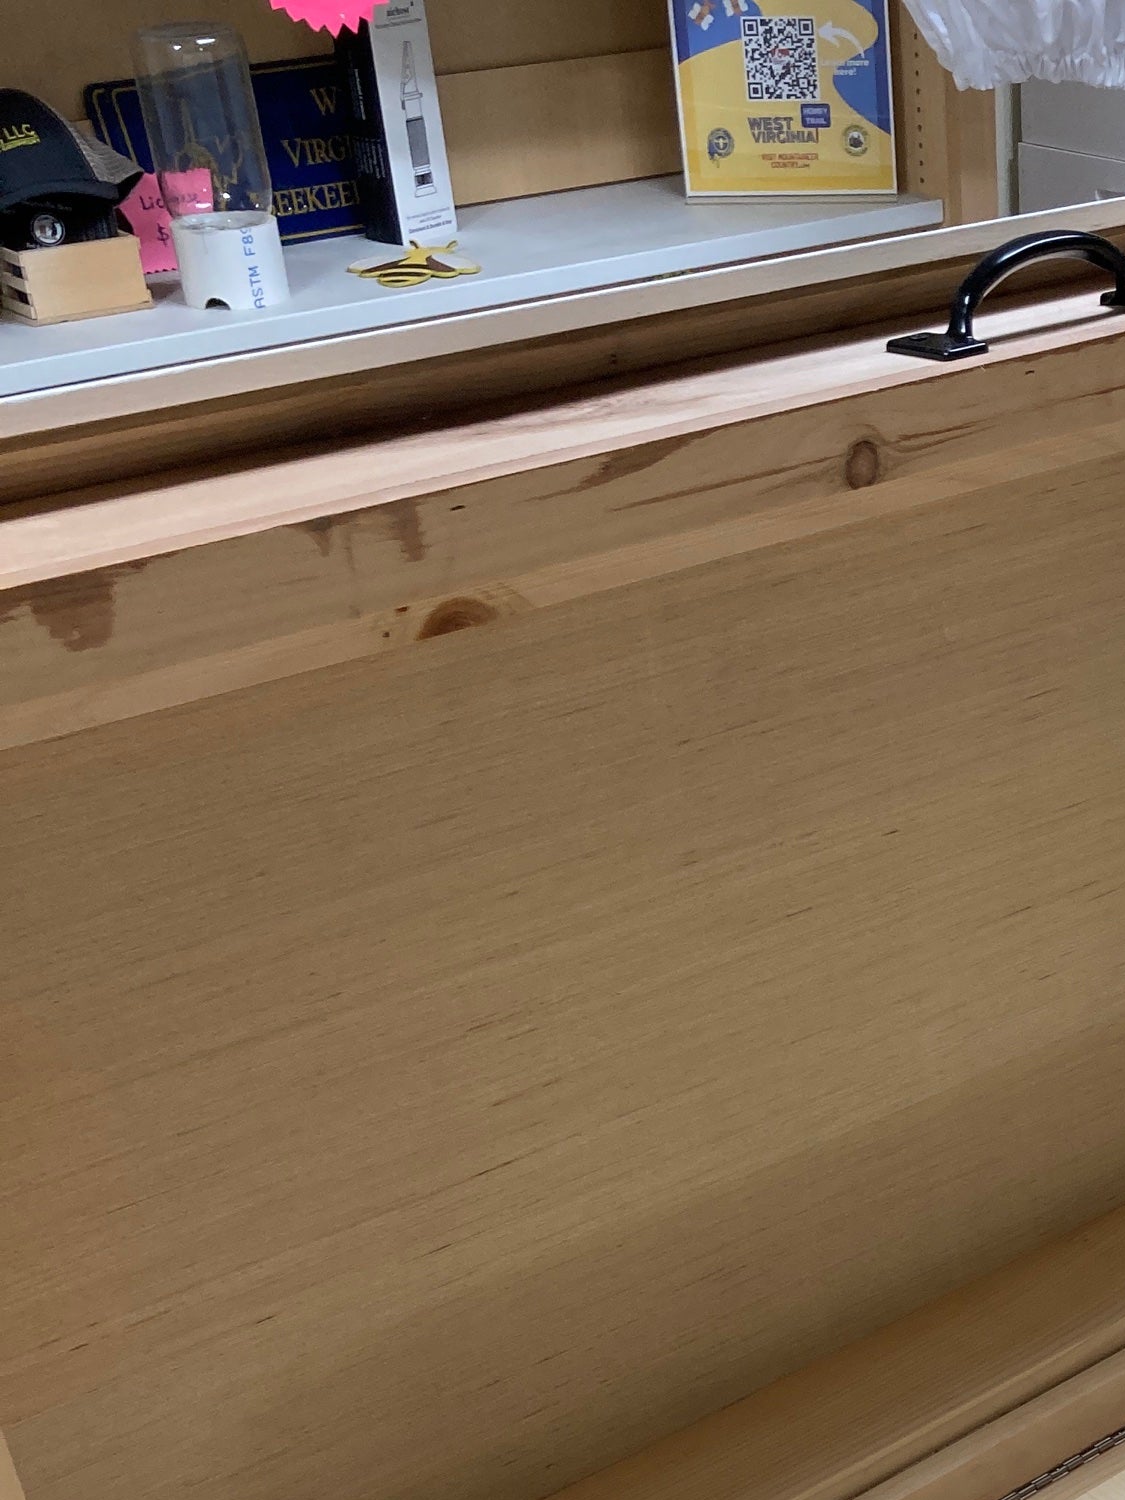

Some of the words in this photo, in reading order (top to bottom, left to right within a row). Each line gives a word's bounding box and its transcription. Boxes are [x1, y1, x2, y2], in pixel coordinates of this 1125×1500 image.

[3, 123, 35, 139] LLC
[747, 117, 794, 131] WEST
[751, 130, 817, 144] VIRGINIA
[271, 180, 360, 216] EEKEE
[247, 265, 267, 309] ASTM
